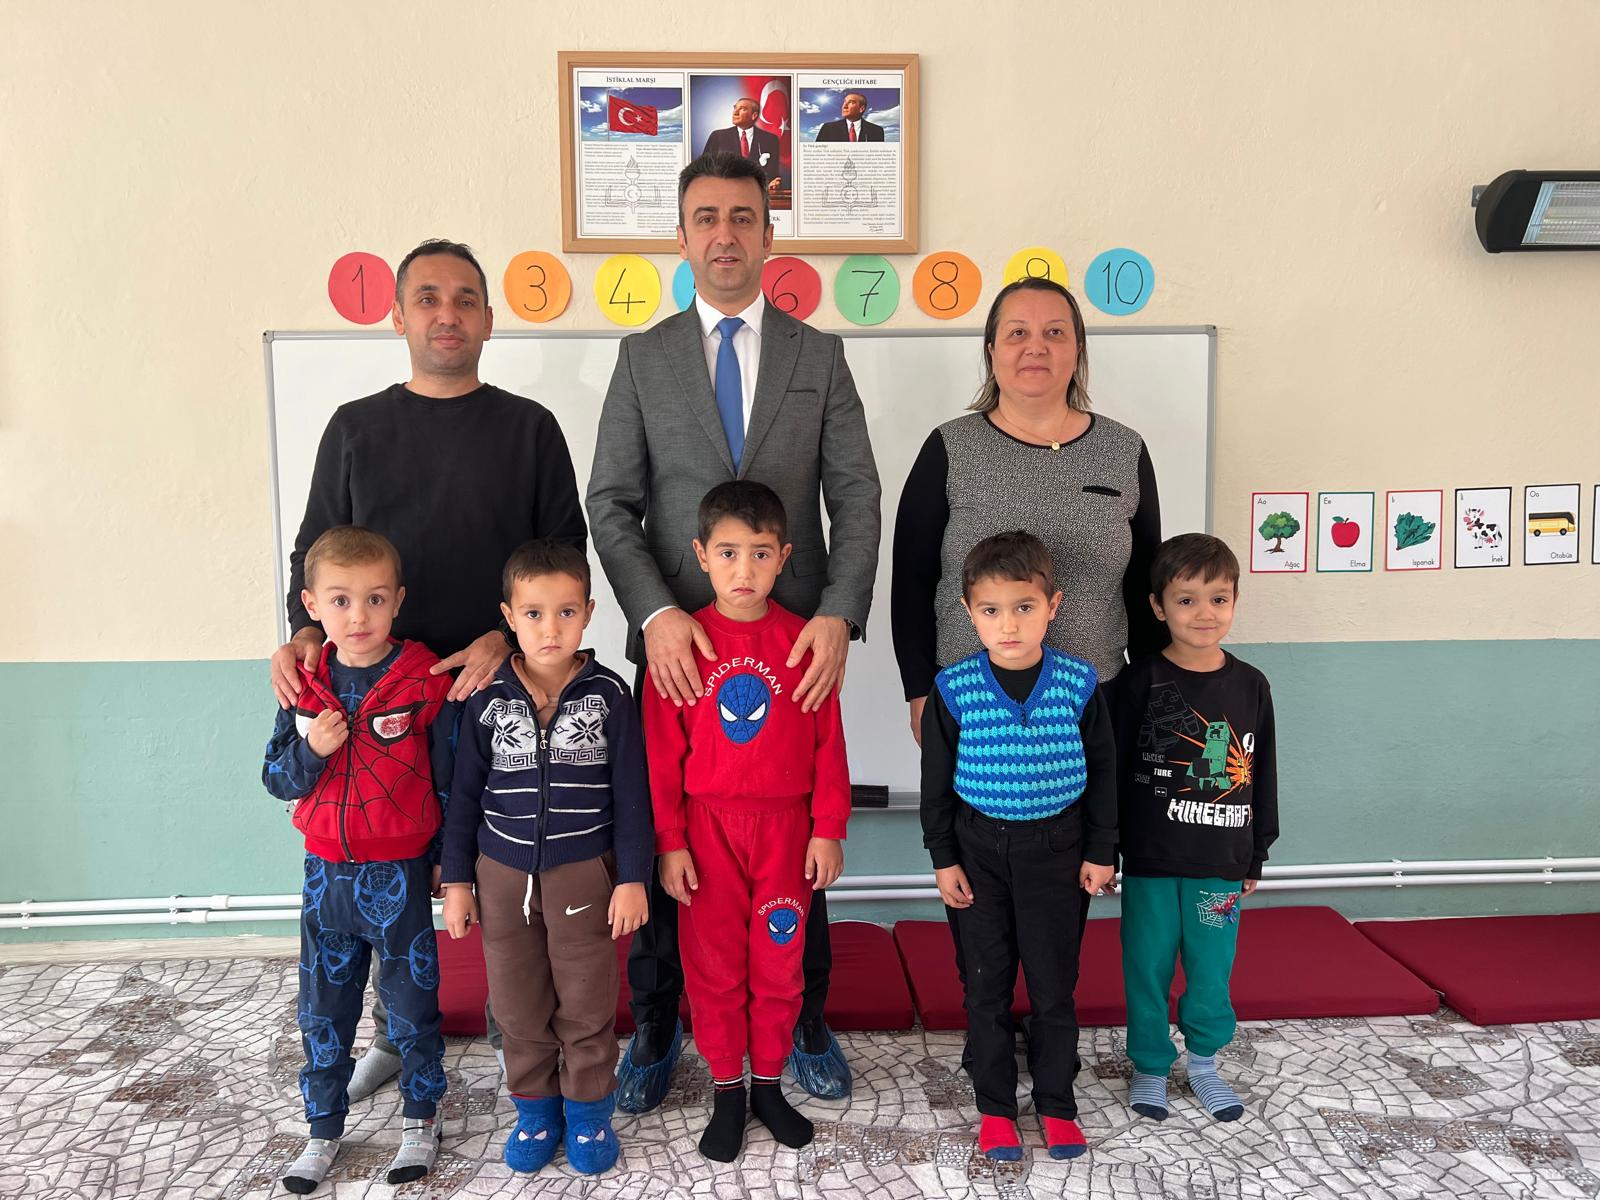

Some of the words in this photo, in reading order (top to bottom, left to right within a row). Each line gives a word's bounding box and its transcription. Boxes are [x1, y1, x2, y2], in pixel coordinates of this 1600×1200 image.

[351, 264, 366, 314] 1
[523, 265, 548, 312] 3
[608, 267, 647, 314] 4
[771, 268, 799, 313] 6
[851, 270, 886, 318] 7
[928, 260, 959, 311] 8
[1101, 260, 1145, 306] 10
[1256, 497, 1267, 505] Aa
[1323, 496, 1332, 505] Ee
[1529, 490, 1540, 498] Oo
[1284, 560, 1301, 570] Ağaç
[1350, 559, 1366, 567] Elma
[704, 656, 783, 697] SPIDERMAN
[1153, 767, 1173, 778] TURE
